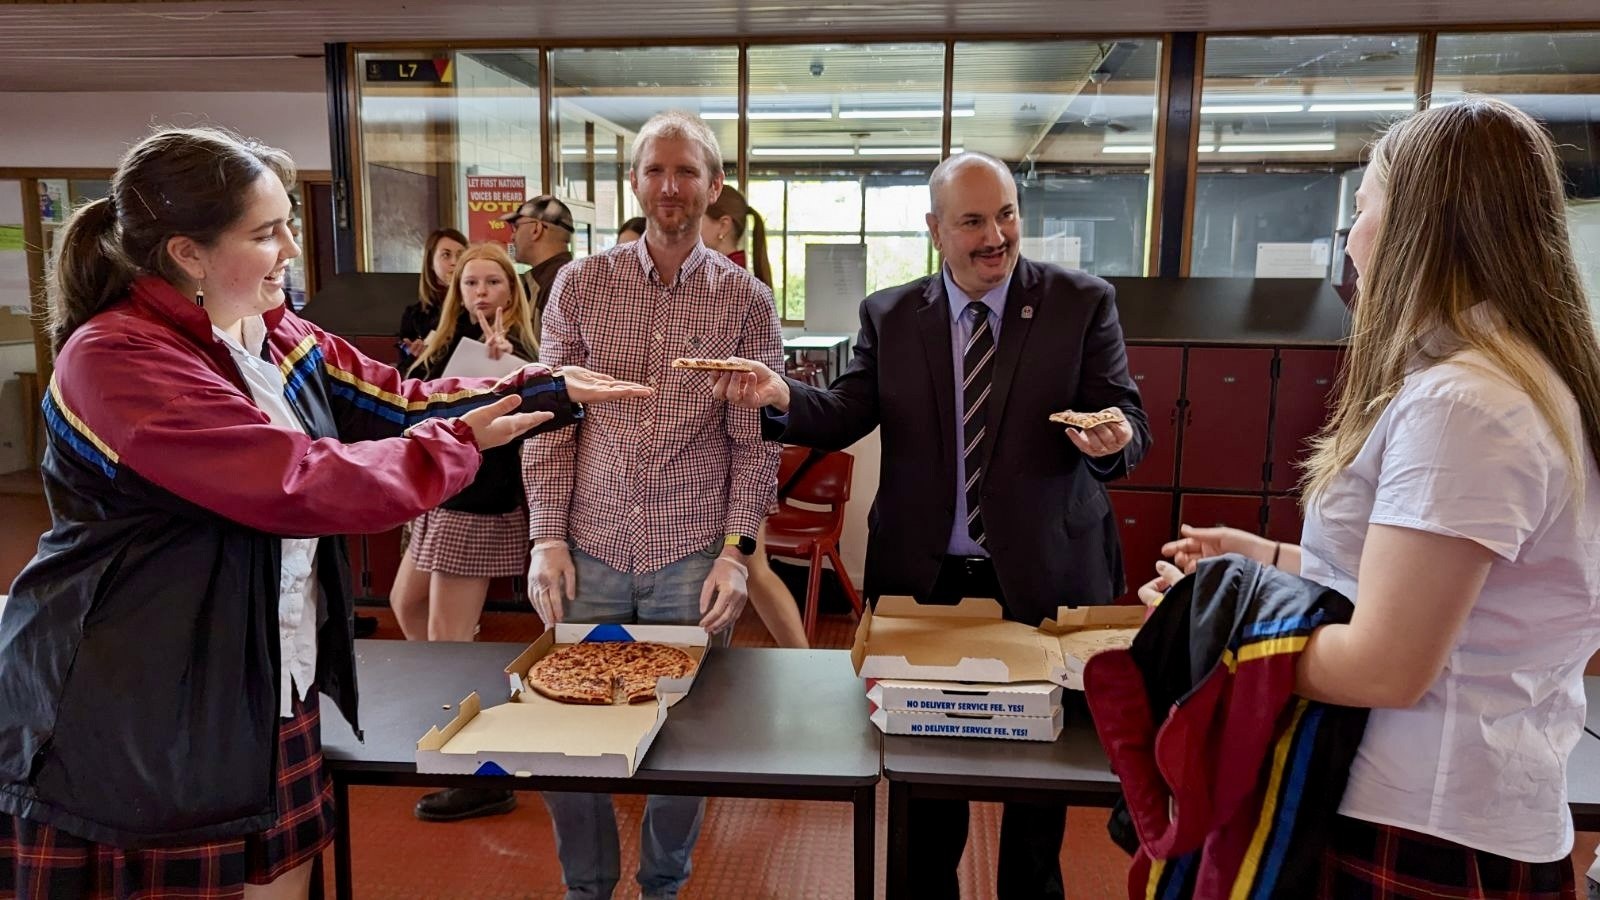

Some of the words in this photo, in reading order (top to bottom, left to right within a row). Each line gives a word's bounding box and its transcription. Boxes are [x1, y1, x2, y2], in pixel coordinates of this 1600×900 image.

[399, 64, 417, 78] L7
[468, 179, 479, 188] LET
[480, 179, 497, 188] FIRST
[498, 179, 524, 188] NATIONS
[470, 191, 492, 201] VOICES
[493, 191, 501, 201] BE
[502, 192, 523, 201] HEARD
[489, 220, 505, 230] Yes
[906, 700, 919, 708] NO
[920, 700, 956, 710] DELIVERY
[957, 702, 988, 711] SERVICE
[990, 703, 1005, 712] FEE.
[1008, 704, 1024, 713] YES!
[911, 724, 923, 732] NO
[924, 724, 960, 733] DELIVERY
[962, 726, 992, 735] SERVICE
[994, 727, 1009, 735] FEE.
[1011, 728, 1028, 736] YES!
